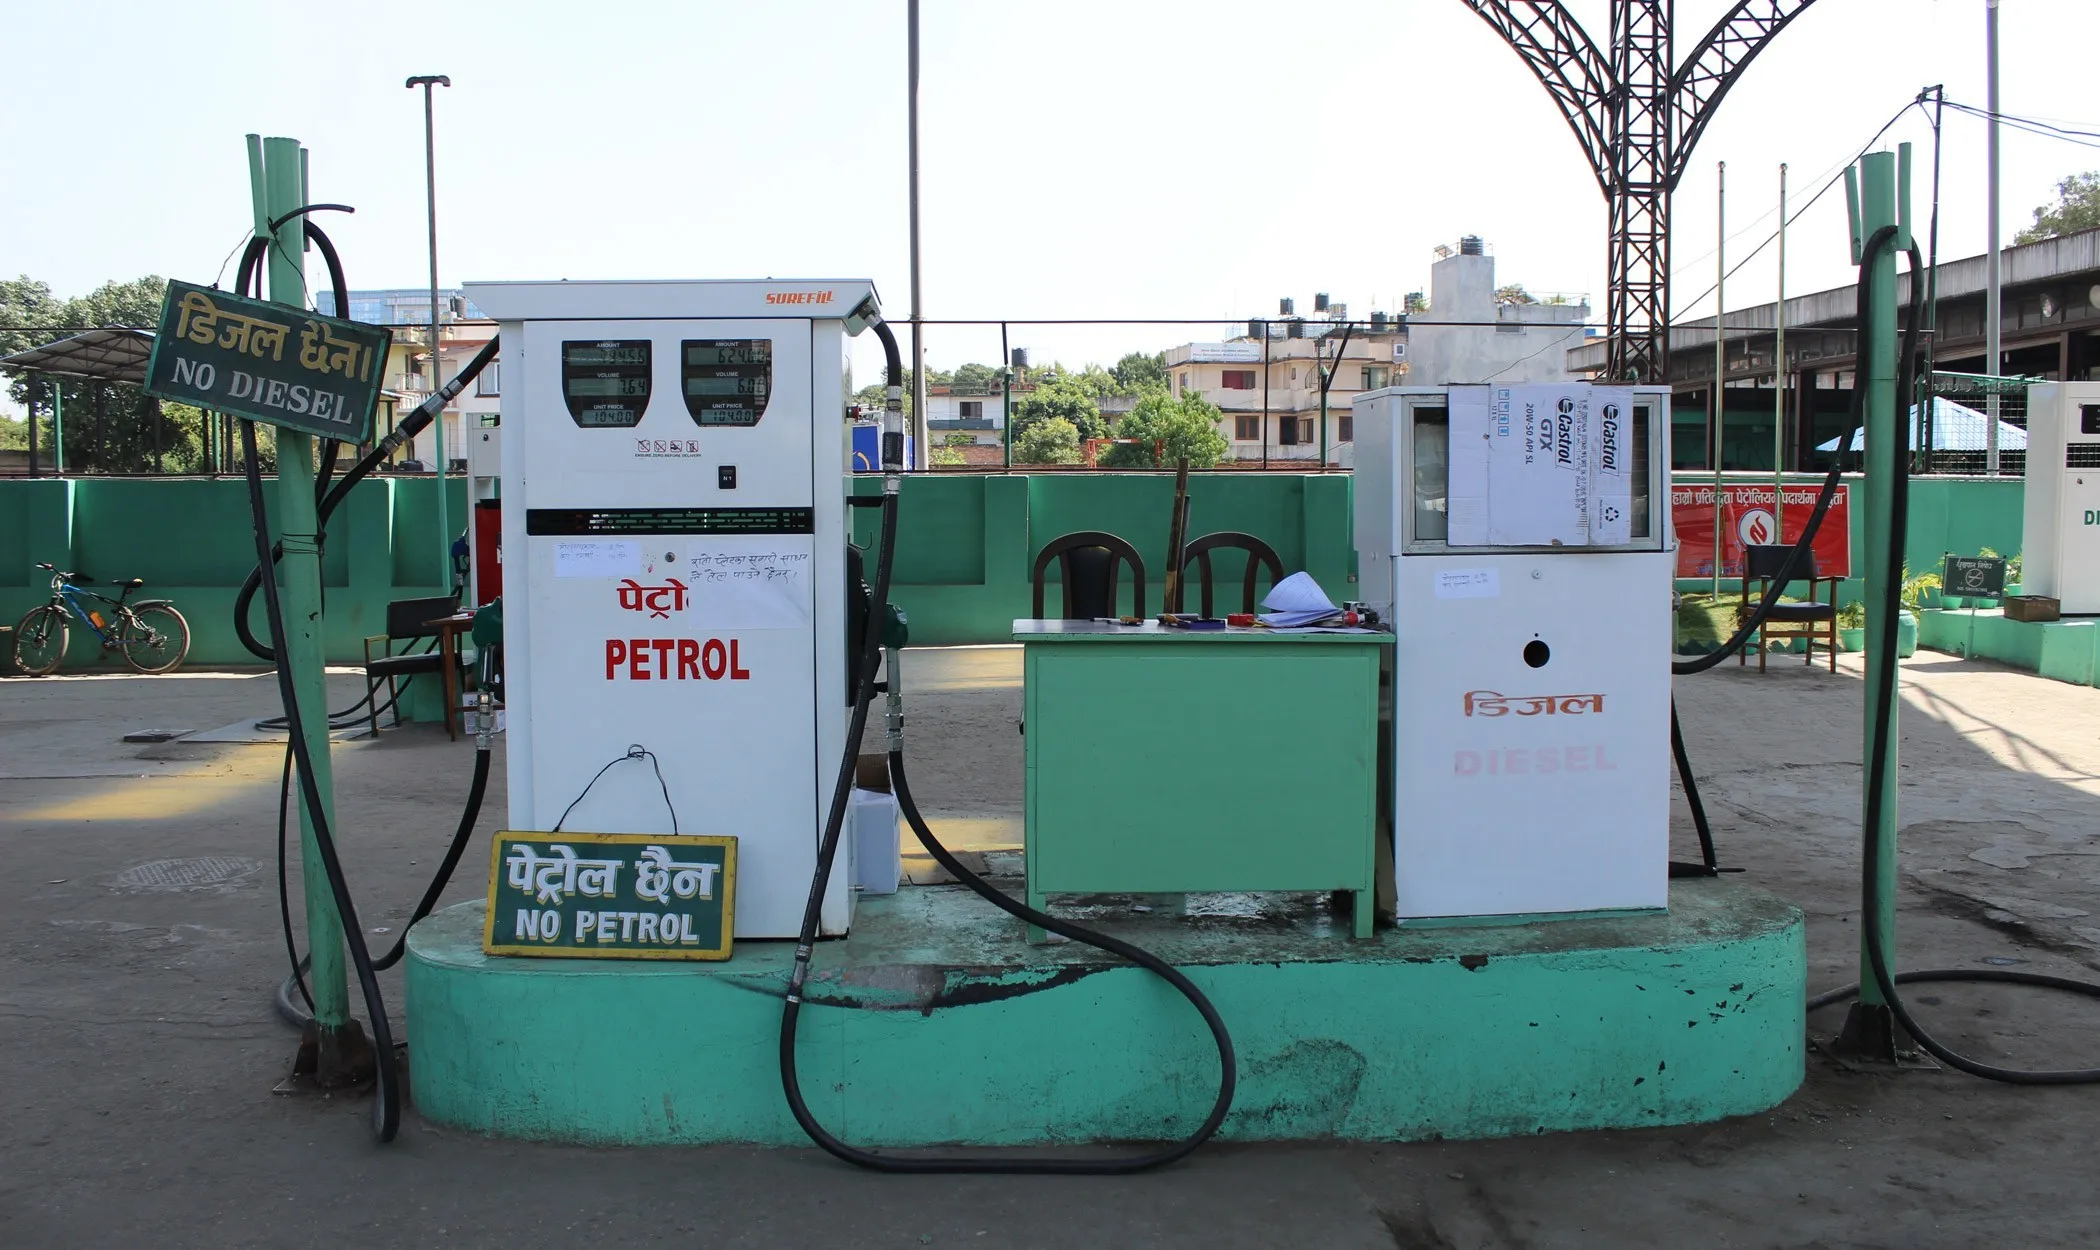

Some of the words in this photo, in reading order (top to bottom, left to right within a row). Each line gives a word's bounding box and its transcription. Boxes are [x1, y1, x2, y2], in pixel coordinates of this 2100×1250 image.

[176, 291, 291, 362] डिजल
[170, 357, 216, 391] NO
[228, 370, 353, 425] DIESEL
[620, 379, 646, 394] 7.64
[594, 411, 632, 422] 104.00
[713, 410, 751, 422] 104.00
[1525, 403, 1534, 436] 20W-50
[1525, 438, 1534, 453] API
[1540, 418, 1553, 453] GTX
[1558, 414, 1573, 465] Castrol
[1602, 421, 1618, 471] Castrol
[1525, 455, 1534, 465] SL
[1672, 488, 1693, 505] हाम्रो
[616, 578, 689, 619] पेट्रो
[606, 638, 750, 680] PETROL
[1464, 690, 1607, 717] डिजल
[1454, 744, 1618, 776] DIESEL
[505, 844, 625, 905] पेट्रोल
[633, 845, 721, 906] छैन
[515, 908, 561, 943] NO
[575, 910, 699, 944] PETROL
